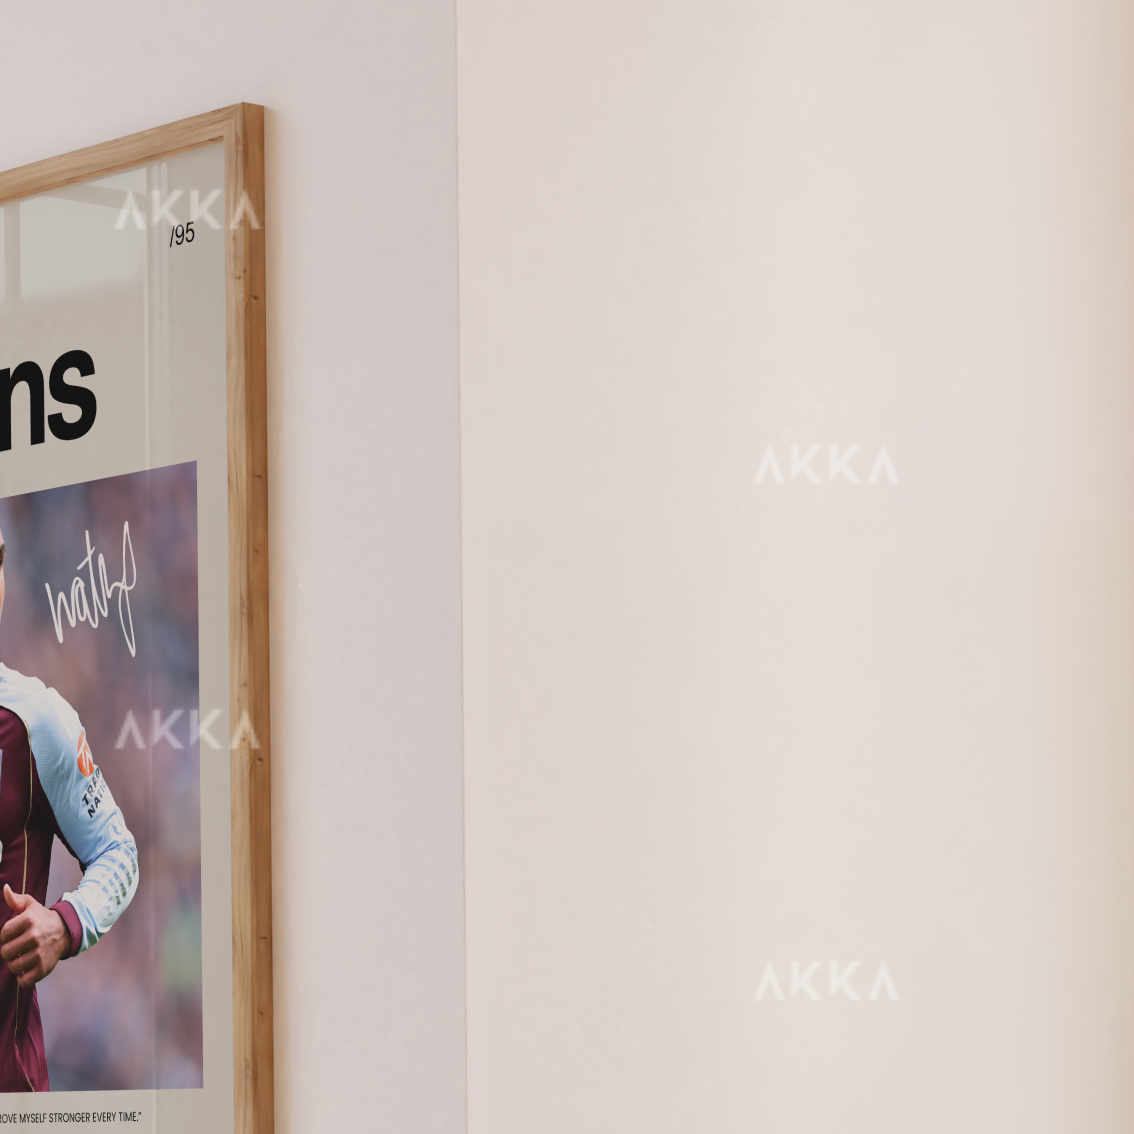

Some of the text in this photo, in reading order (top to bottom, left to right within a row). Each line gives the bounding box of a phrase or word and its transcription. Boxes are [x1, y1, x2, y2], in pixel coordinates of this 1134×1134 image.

[169, 221, 195, 248] /95
[19, 1113, 47, 1123] MYSELF
[49, 1113, 90, 1122] STRONGER
[92, 1112, 116, 1122] EVERY
